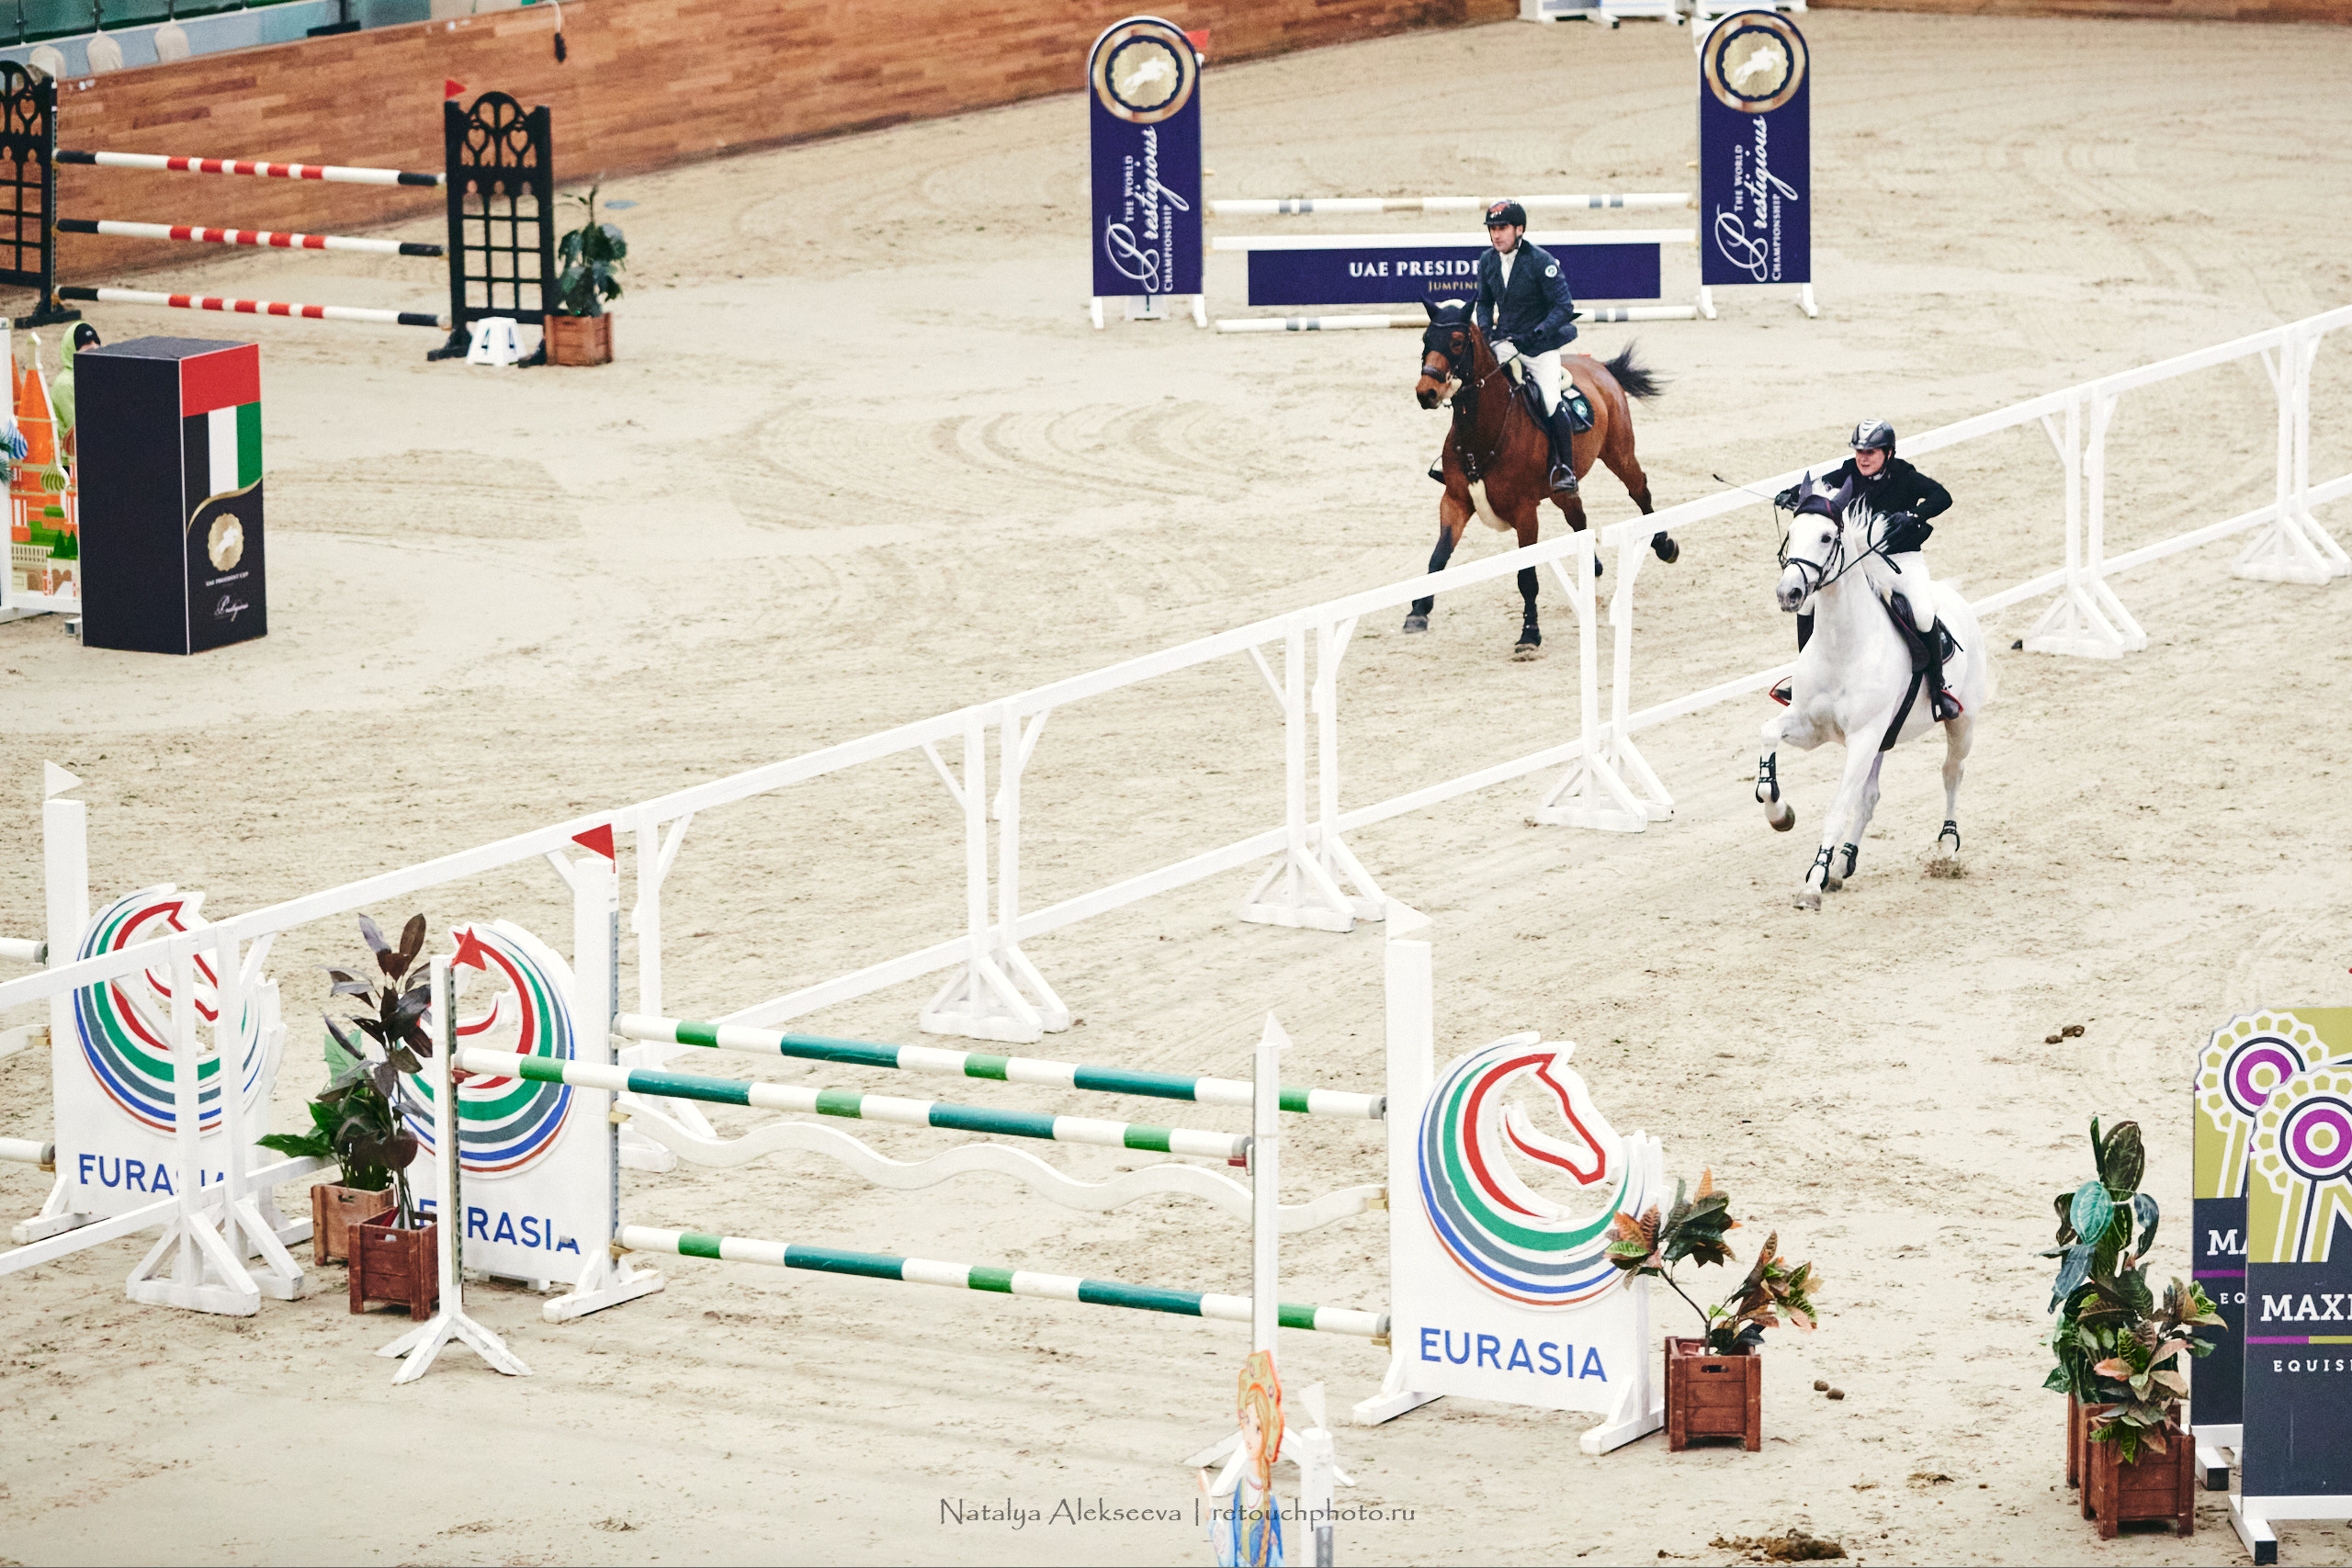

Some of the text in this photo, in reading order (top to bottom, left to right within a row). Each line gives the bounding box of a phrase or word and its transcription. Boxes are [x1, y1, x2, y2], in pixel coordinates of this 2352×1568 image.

[1123, 154, 1135, 197] WORLD
[1714, 115, 1799, 282] Prestigious
[1734, 144, 1744, 186] WORLD
[1106, 125, 1190, 293] Prestigious
[1771, 193, 1782, 282] CHAMPIONSHIP
[1162, 204, 1174, 293] CHAMPIONSHIP
[1349, 261, 1389, 278] UAE
[1420, 1326, 1608, 1382] EURASIA
